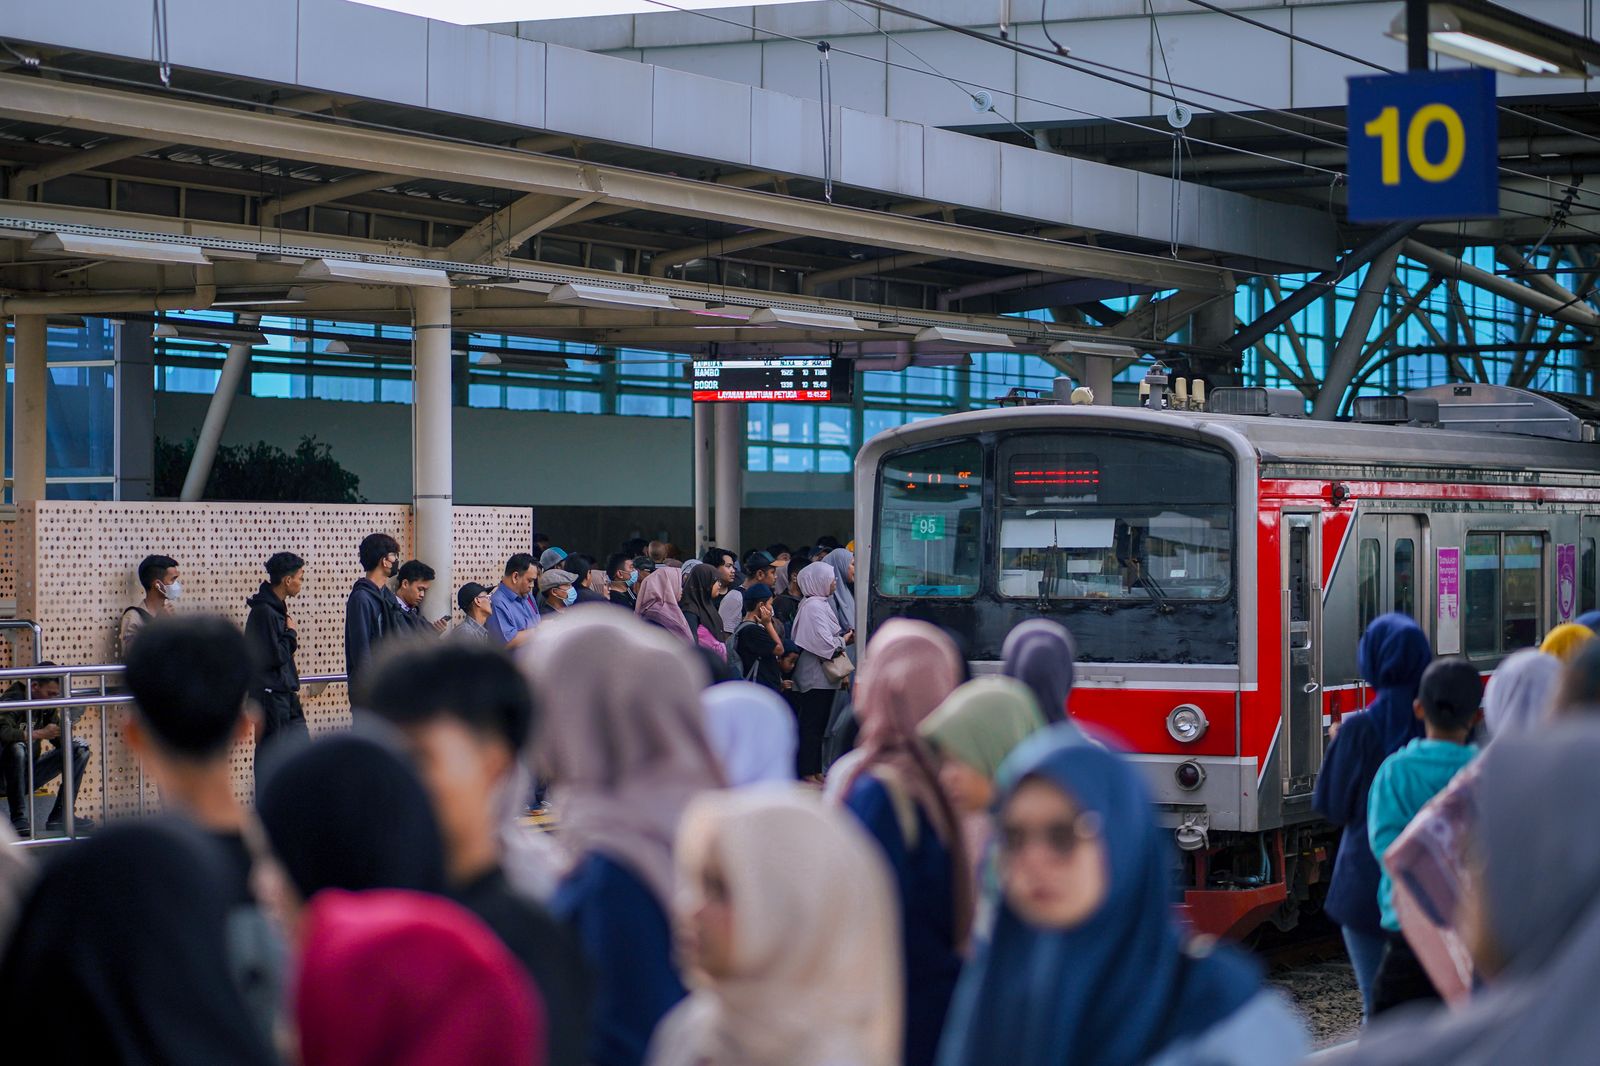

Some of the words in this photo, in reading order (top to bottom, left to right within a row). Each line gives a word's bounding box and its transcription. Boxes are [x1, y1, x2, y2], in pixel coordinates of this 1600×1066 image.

[1364, 103, 1466, 186] 10
[694, 368, 720, 377] NAMBO
[694, 380, 719, 389] BOGOR
[919, 519, 936, 534] 95
